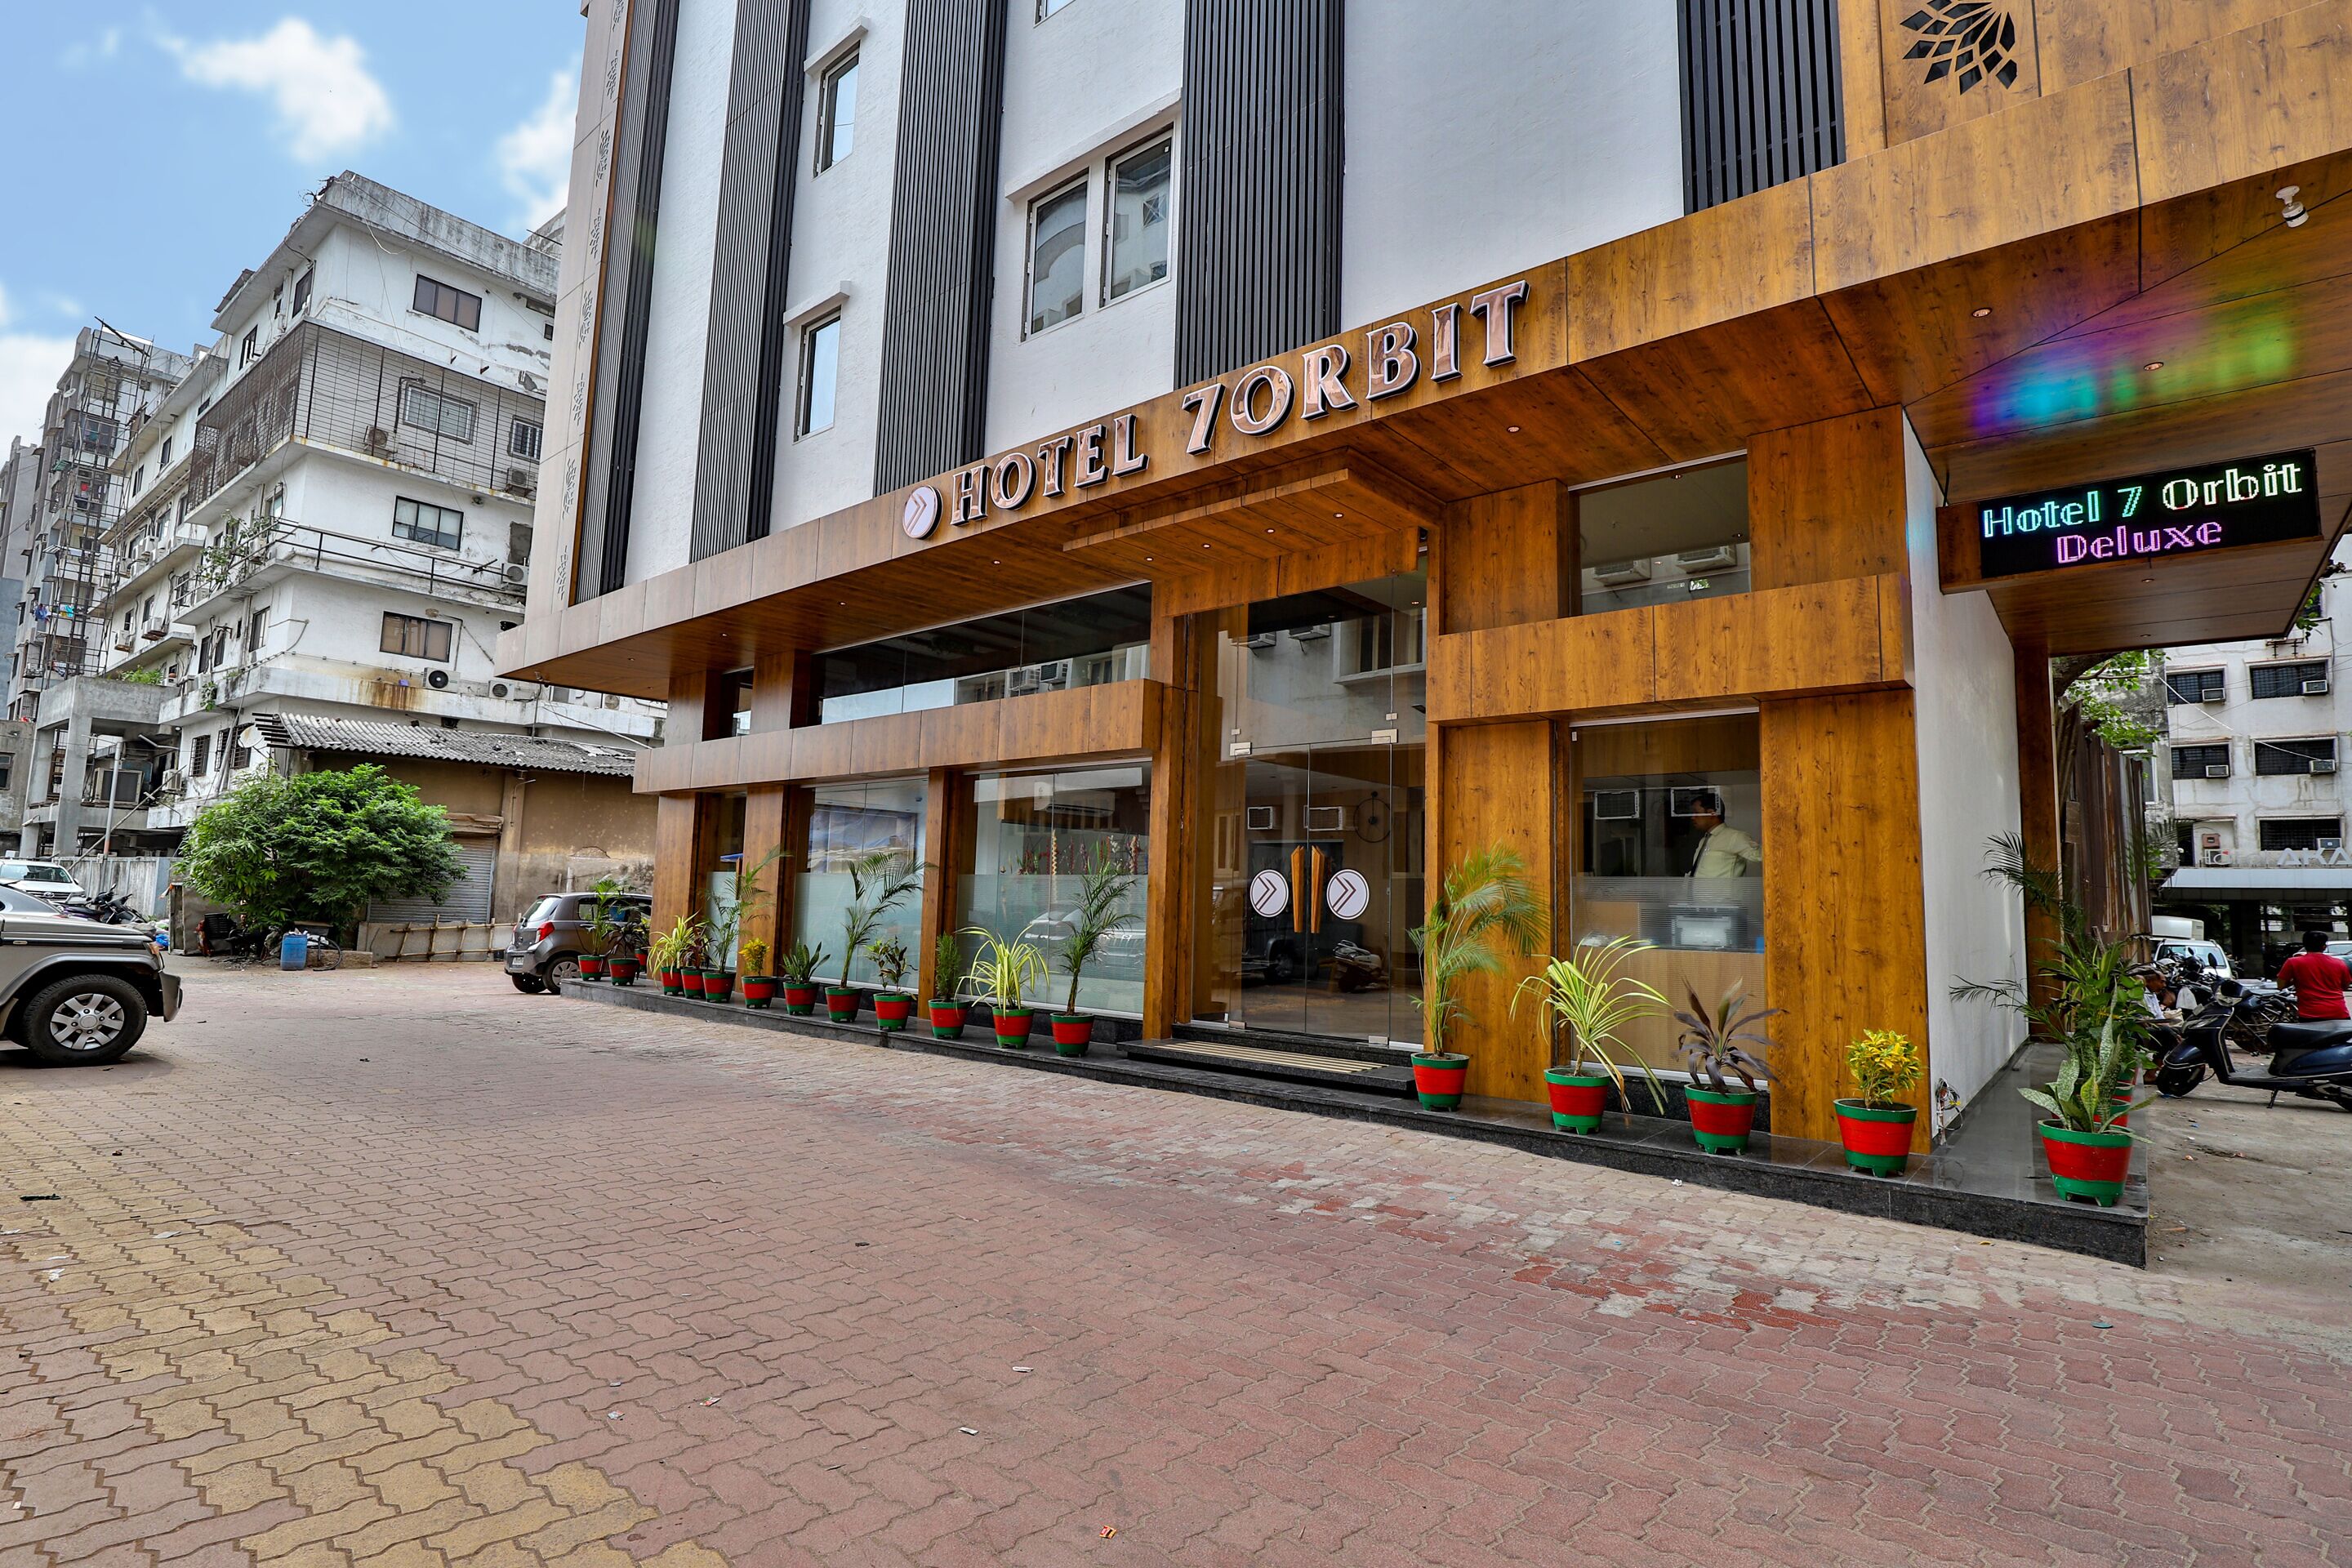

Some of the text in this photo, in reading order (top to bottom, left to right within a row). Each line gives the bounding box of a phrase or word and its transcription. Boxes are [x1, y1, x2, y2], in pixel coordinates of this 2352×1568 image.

[950, 413, 1149, 527] HOTEL
[1984, 463, 2302, 537] Hotel 7 Orbit
[2057, 521, 2222, 564] Deluxe
